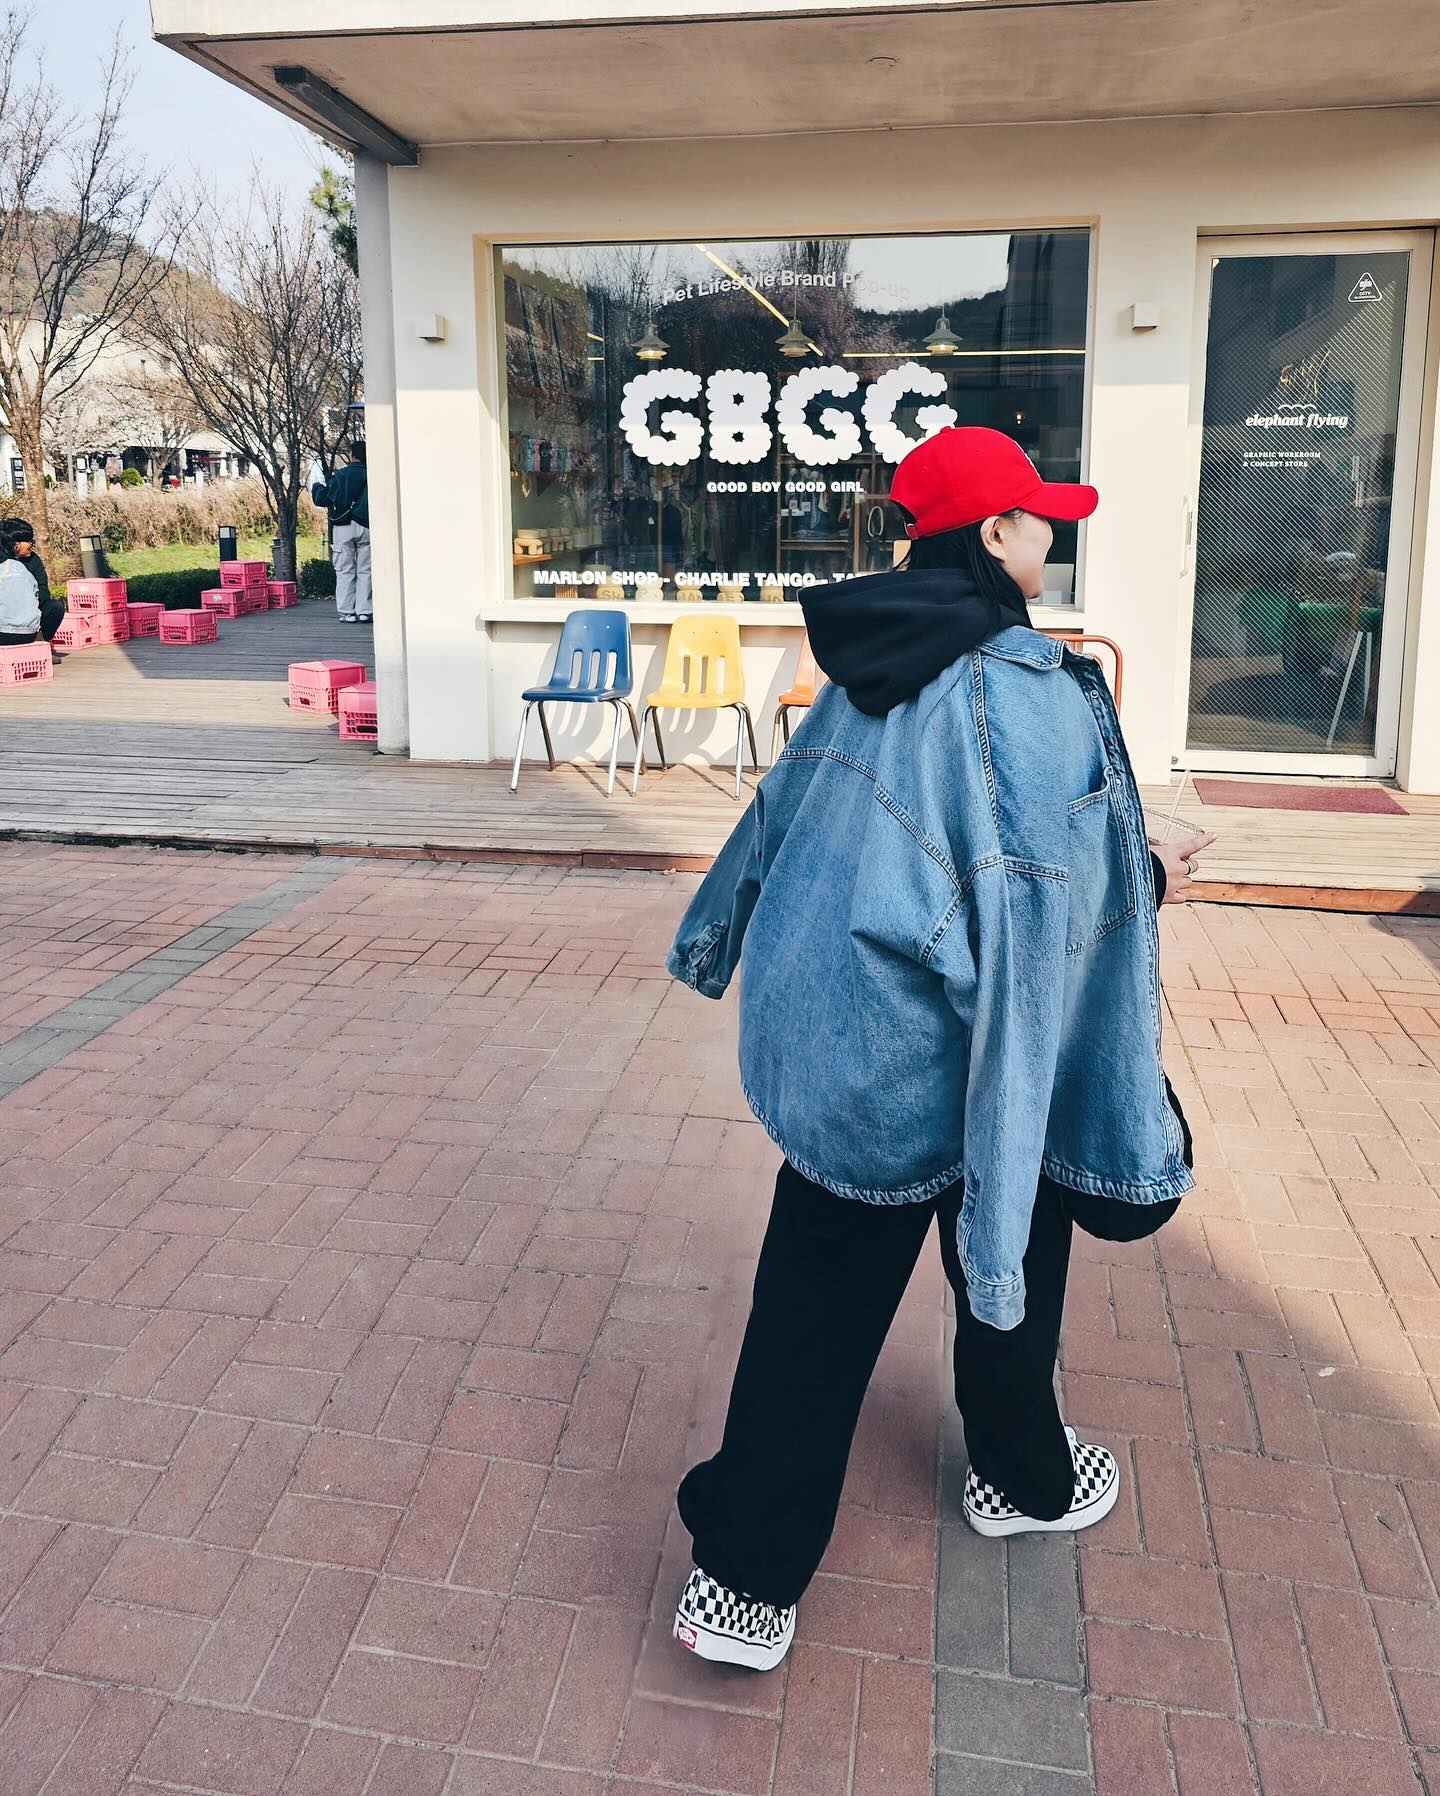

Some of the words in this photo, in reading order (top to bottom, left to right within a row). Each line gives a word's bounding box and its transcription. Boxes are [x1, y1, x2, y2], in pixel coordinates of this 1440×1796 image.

[664, 285, 693, 306] Pet
[698, 271, 776, 297] Lifestyle
[781, 269, 836, 288] Brand
[1246, 414, 1304, 428] elephant
[1306, 414, 1348, 428] flying
[707, 481, 748, 493] GOOD
[751, 481, 781, 493] BOY
[785, 481, 827, 493] GOOD
[831, 481, 864, 493] GIRL
[533, 570, 607, 585] MARLON
[610, 571, 659, 586] SHOP
[674, 572, 750, 587] CHARLIE
[754, 573, 816, 588] TANGO
